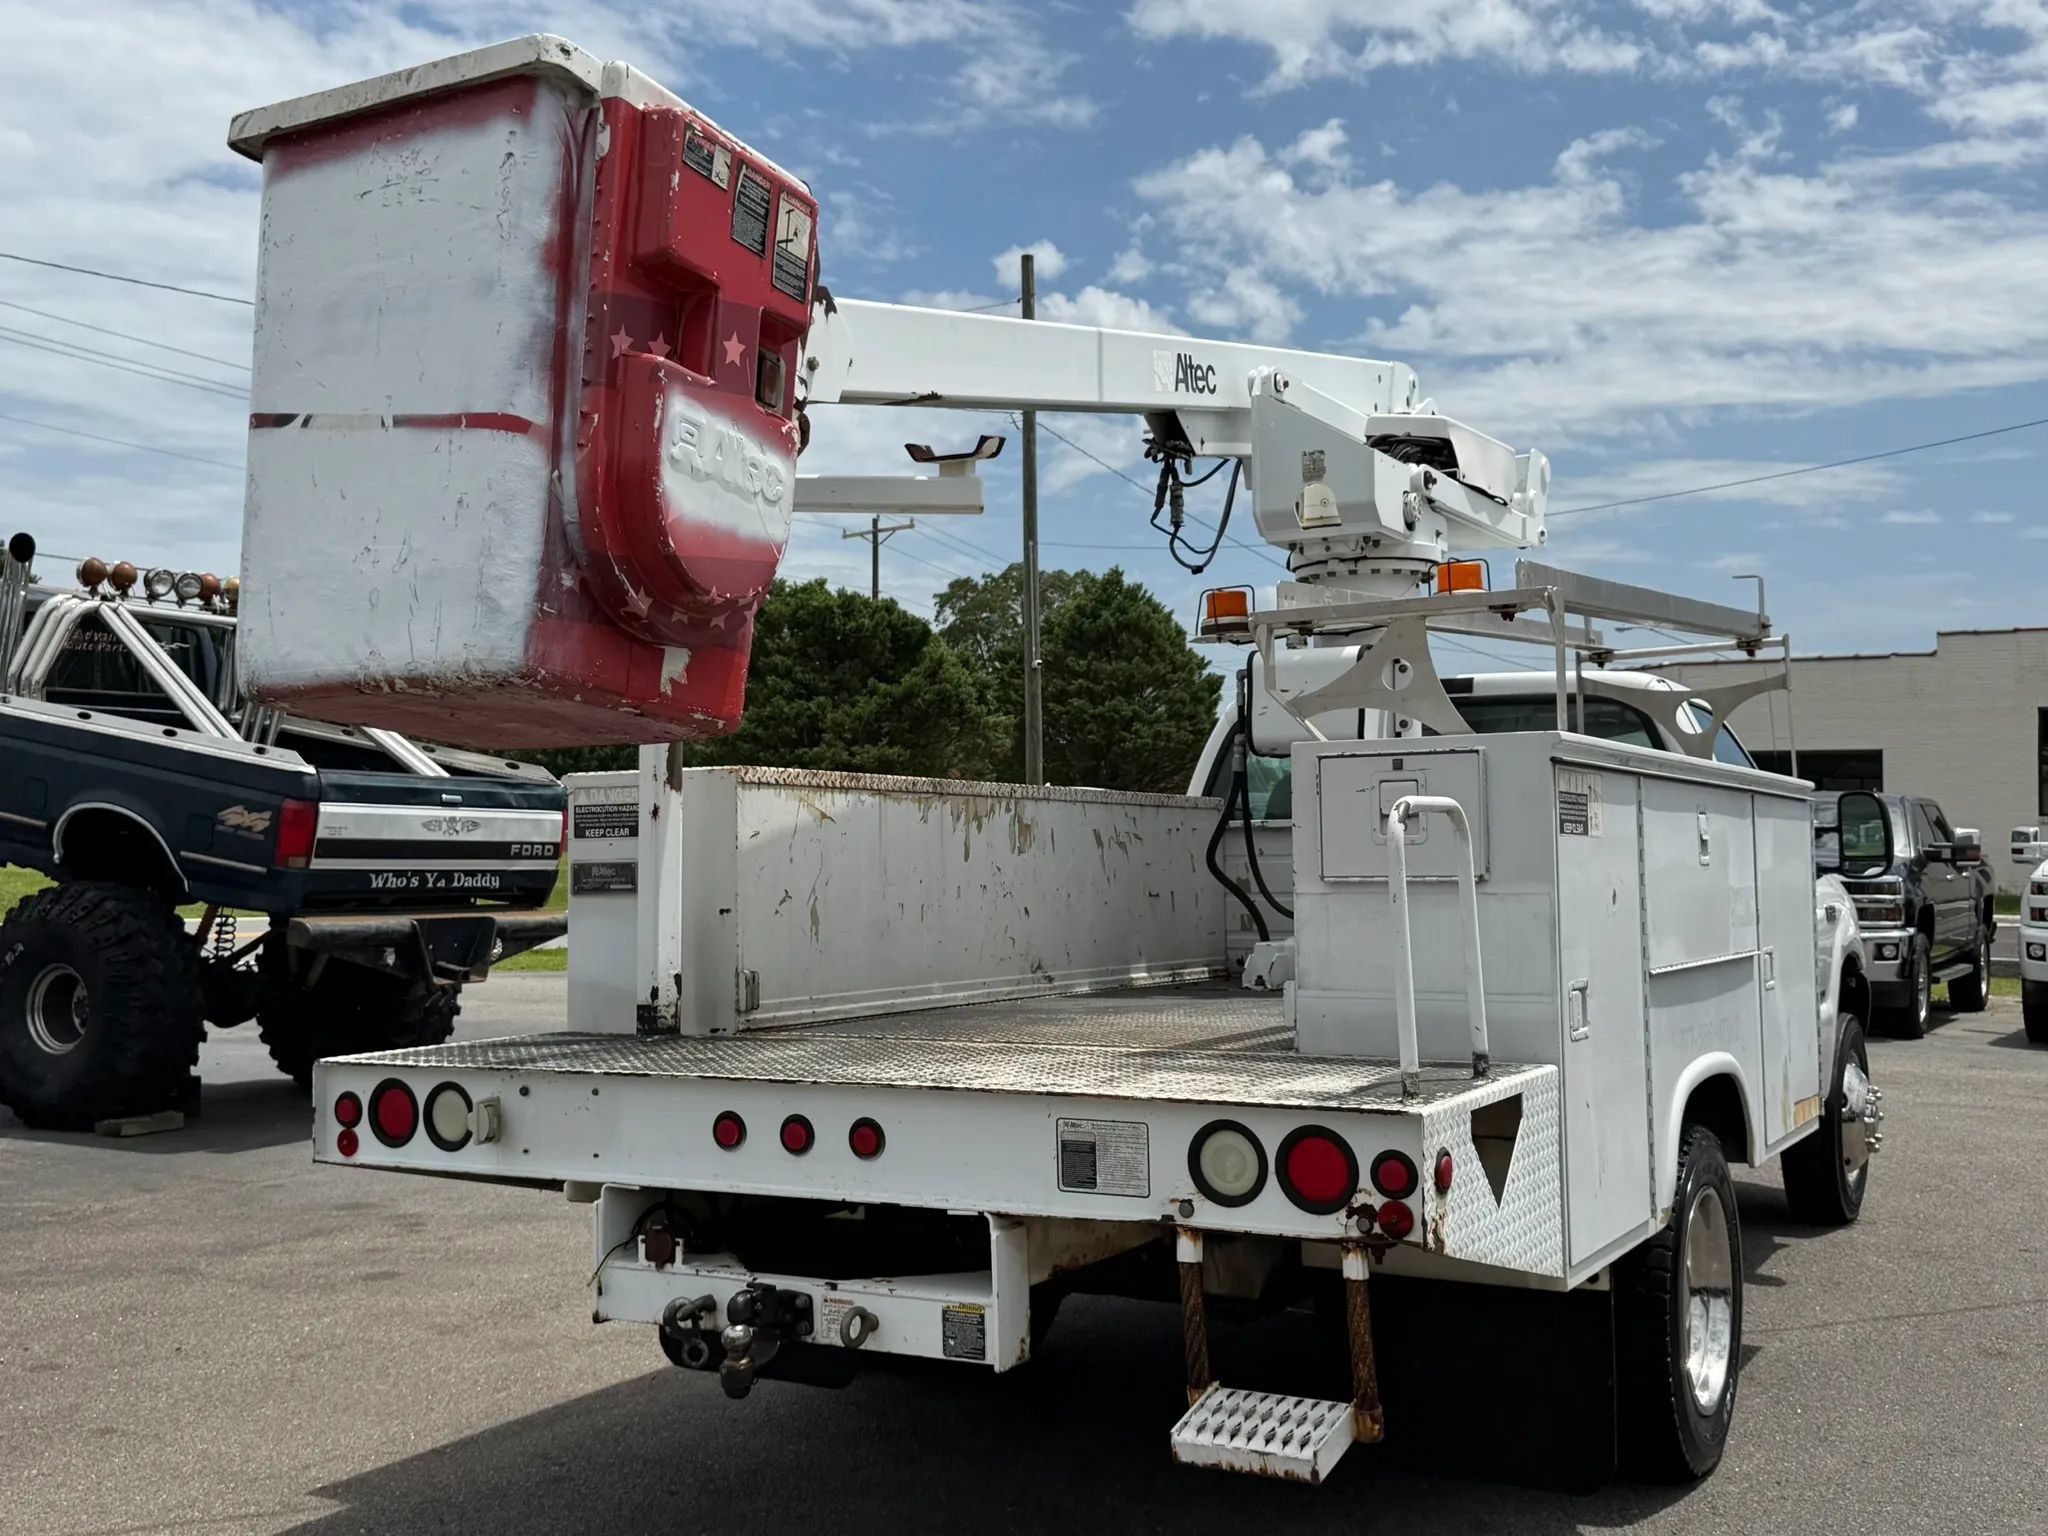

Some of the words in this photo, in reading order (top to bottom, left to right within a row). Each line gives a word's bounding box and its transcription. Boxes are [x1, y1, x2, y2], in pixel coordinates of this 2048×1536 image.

[1175, 352, 1217, 395] Altec
[590, 788, 639, 803] DANGER
[575, 805, 618, 814] ELECTROCUTION
[585, 828, 604, 838] KEEP
[605, 827, 630, 837] CLEAR
[510, 844, 554, 856] FORD
[369, 871, 419, 888] Who's
[425, 872, 446, 888] Ya
[451, 873, 500, 889] Daddy
